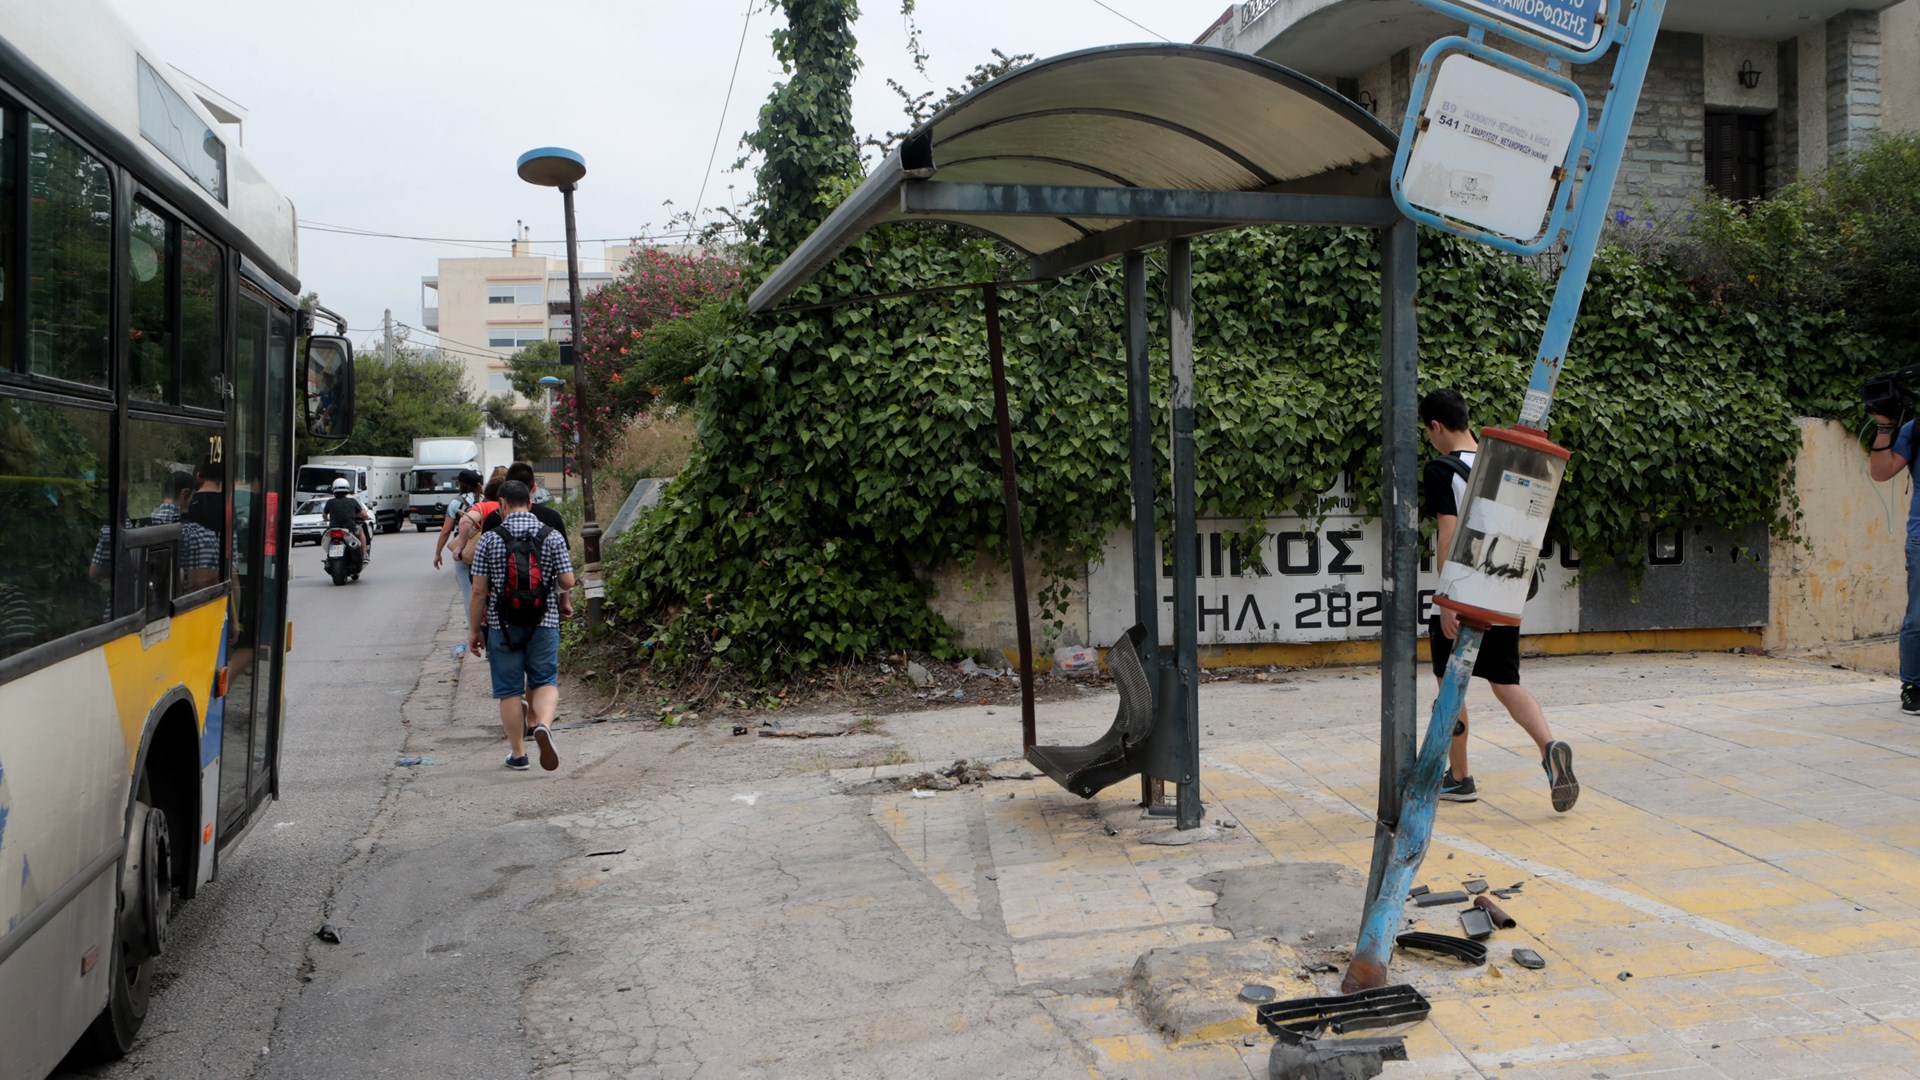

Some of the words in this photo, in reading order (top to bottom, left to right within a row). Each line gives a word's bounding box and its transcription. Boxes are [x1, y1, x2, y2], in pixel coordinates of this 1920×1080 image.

[1491, 0, 1587, 36] ΜΟΡΦΩΣΗΣ
[1438, 115, 1460, 130] 541
[209, 435, 222, 465] 729
[1163, 593, 1281, 632] ΗΛ.
